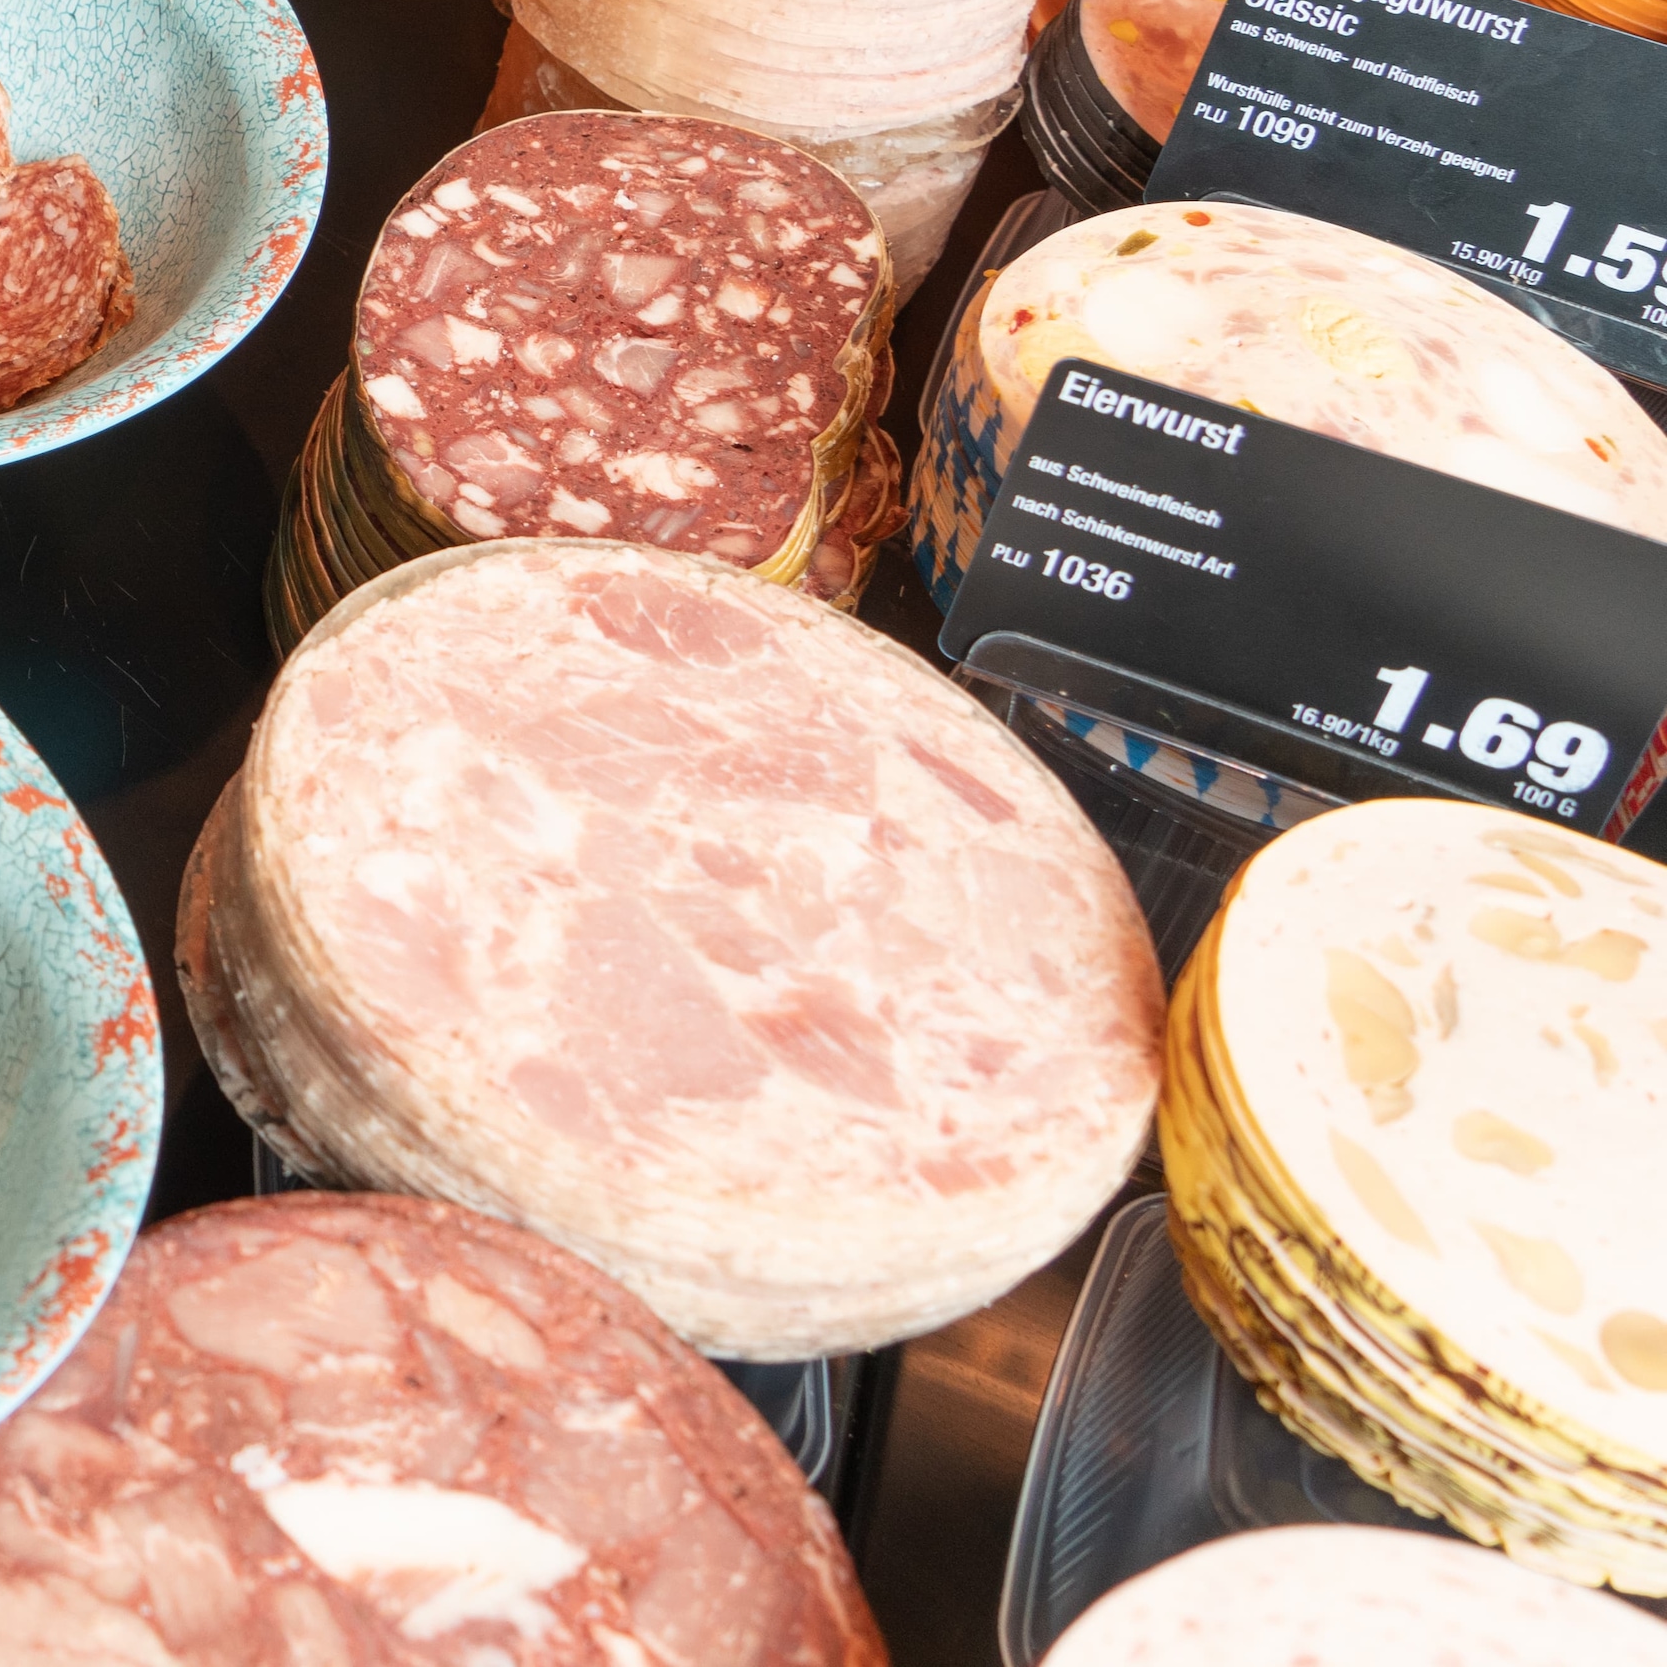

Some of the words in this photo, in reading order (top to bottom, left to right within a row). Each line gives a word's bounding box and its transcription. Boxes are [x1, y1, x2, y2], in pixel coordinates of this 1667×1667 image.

[1229, 19, 1261, 37] aus
[1262, 26, 1349, 63] Schweine-
[1351, 56, 1387, 76] und
[1385, 64, 1480, 106] Rindfleisch
[1192, 101, 1228, 123] PLU
[1237, 104, 1320, 150] 1099
[1206, 71, 1292, 111] Wursthülle
[1293, 102, 1338, 126] nicht
[1336, 116, 1374, 137] zum
[1376, 125, 1441, 157] Verzehr
[1438, 150, 1516, 183] geeignet
[1450, 240, 1543, 285] 15.90/1kg
[1057, 369, 1245, 455] Eierwurst
[1027, 454, 1065, 477] aus
[1065, 464, 1221, 528] Schweinefleisch
[990, 542, 1031, 568] PLU
[1041, 548, 1133, 600] 1036
[1011, 494, 1060, 521] nach
[1060, 508, 1203, 568] Schinkenwurst
[1199, 555, 1235, 578] Art
[1291, 702, 1400, 757] 16.90/1kg
[1374, 666, 1610, 792] 1.69
[1512, 780, 1560, 808] 100
[1556, 797, 1577, 817] G
